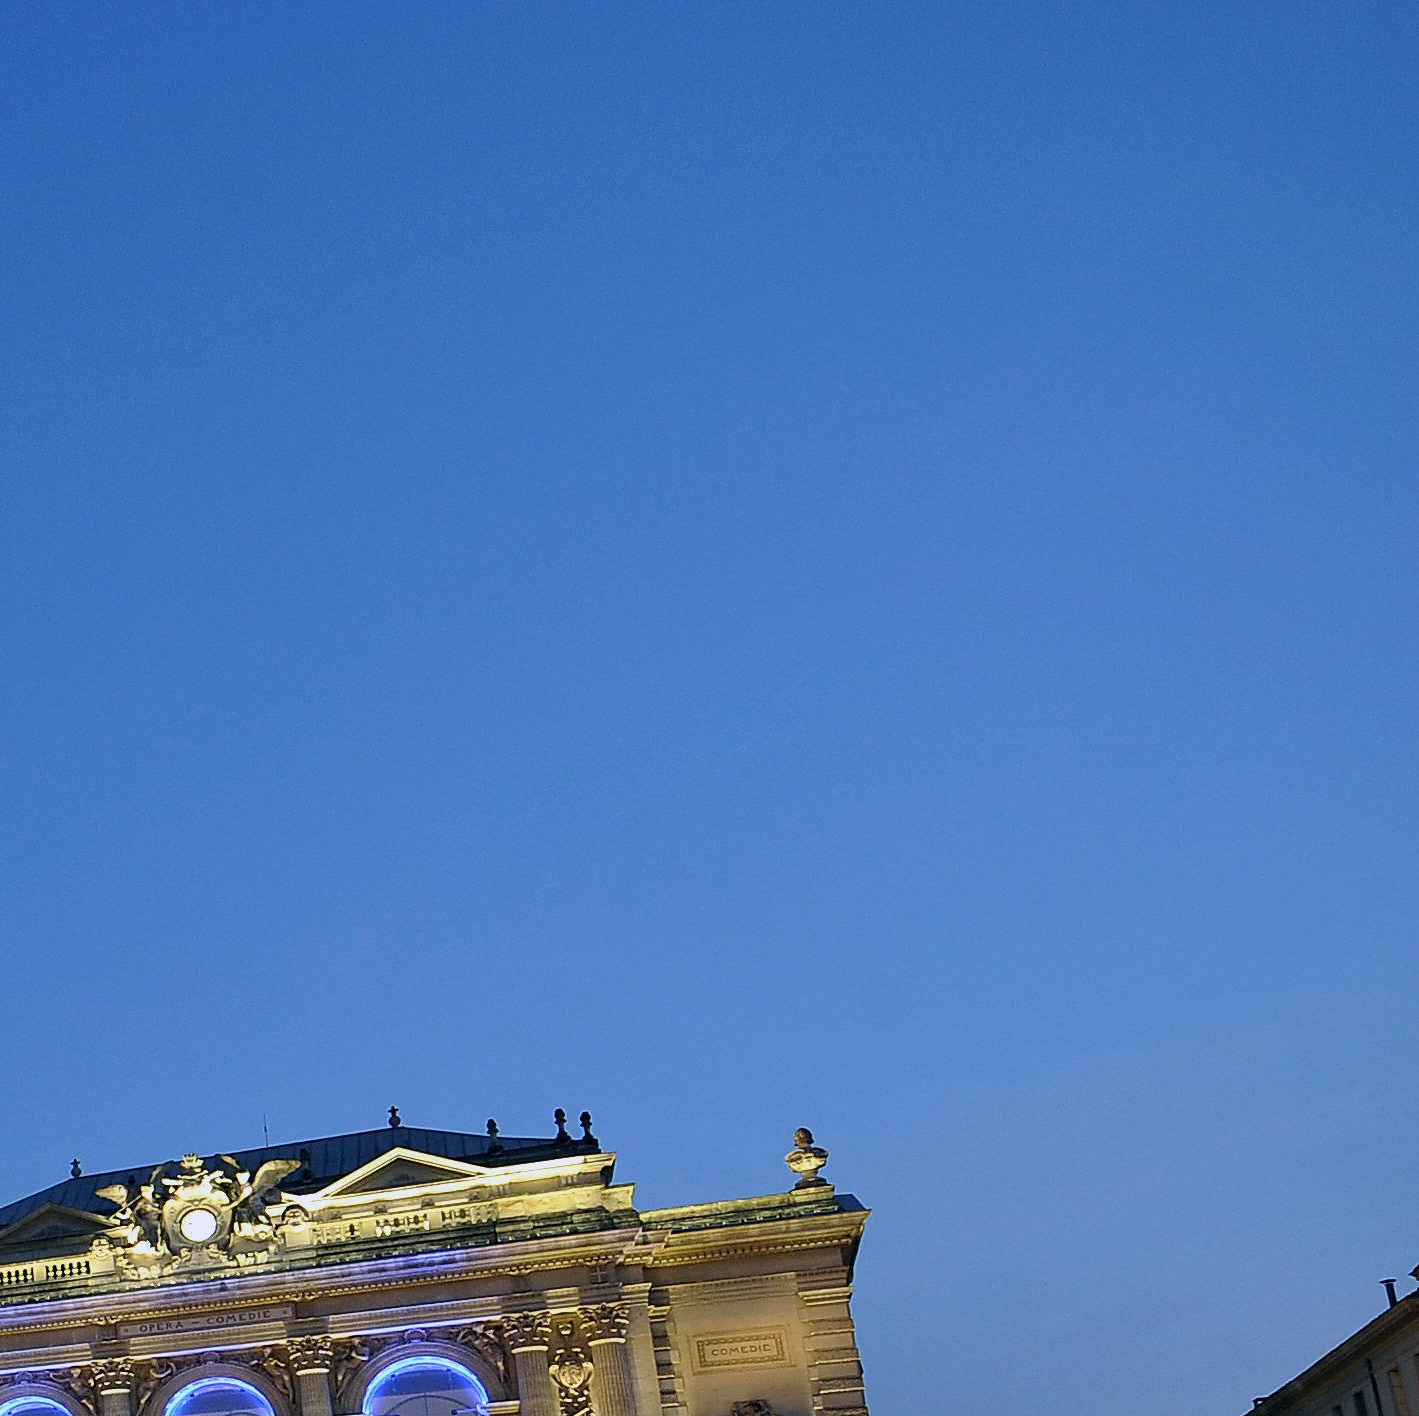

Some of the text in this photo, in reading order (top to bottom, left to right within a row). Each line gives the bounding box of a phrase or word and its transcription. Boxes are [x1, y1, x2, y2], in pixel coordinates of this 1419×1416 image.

[139, 1321, 184, 1333] OPERA
[206, 1310, 272, 1325] COMEDIE
[711, 1344, 771, 1357] COMEDIE
